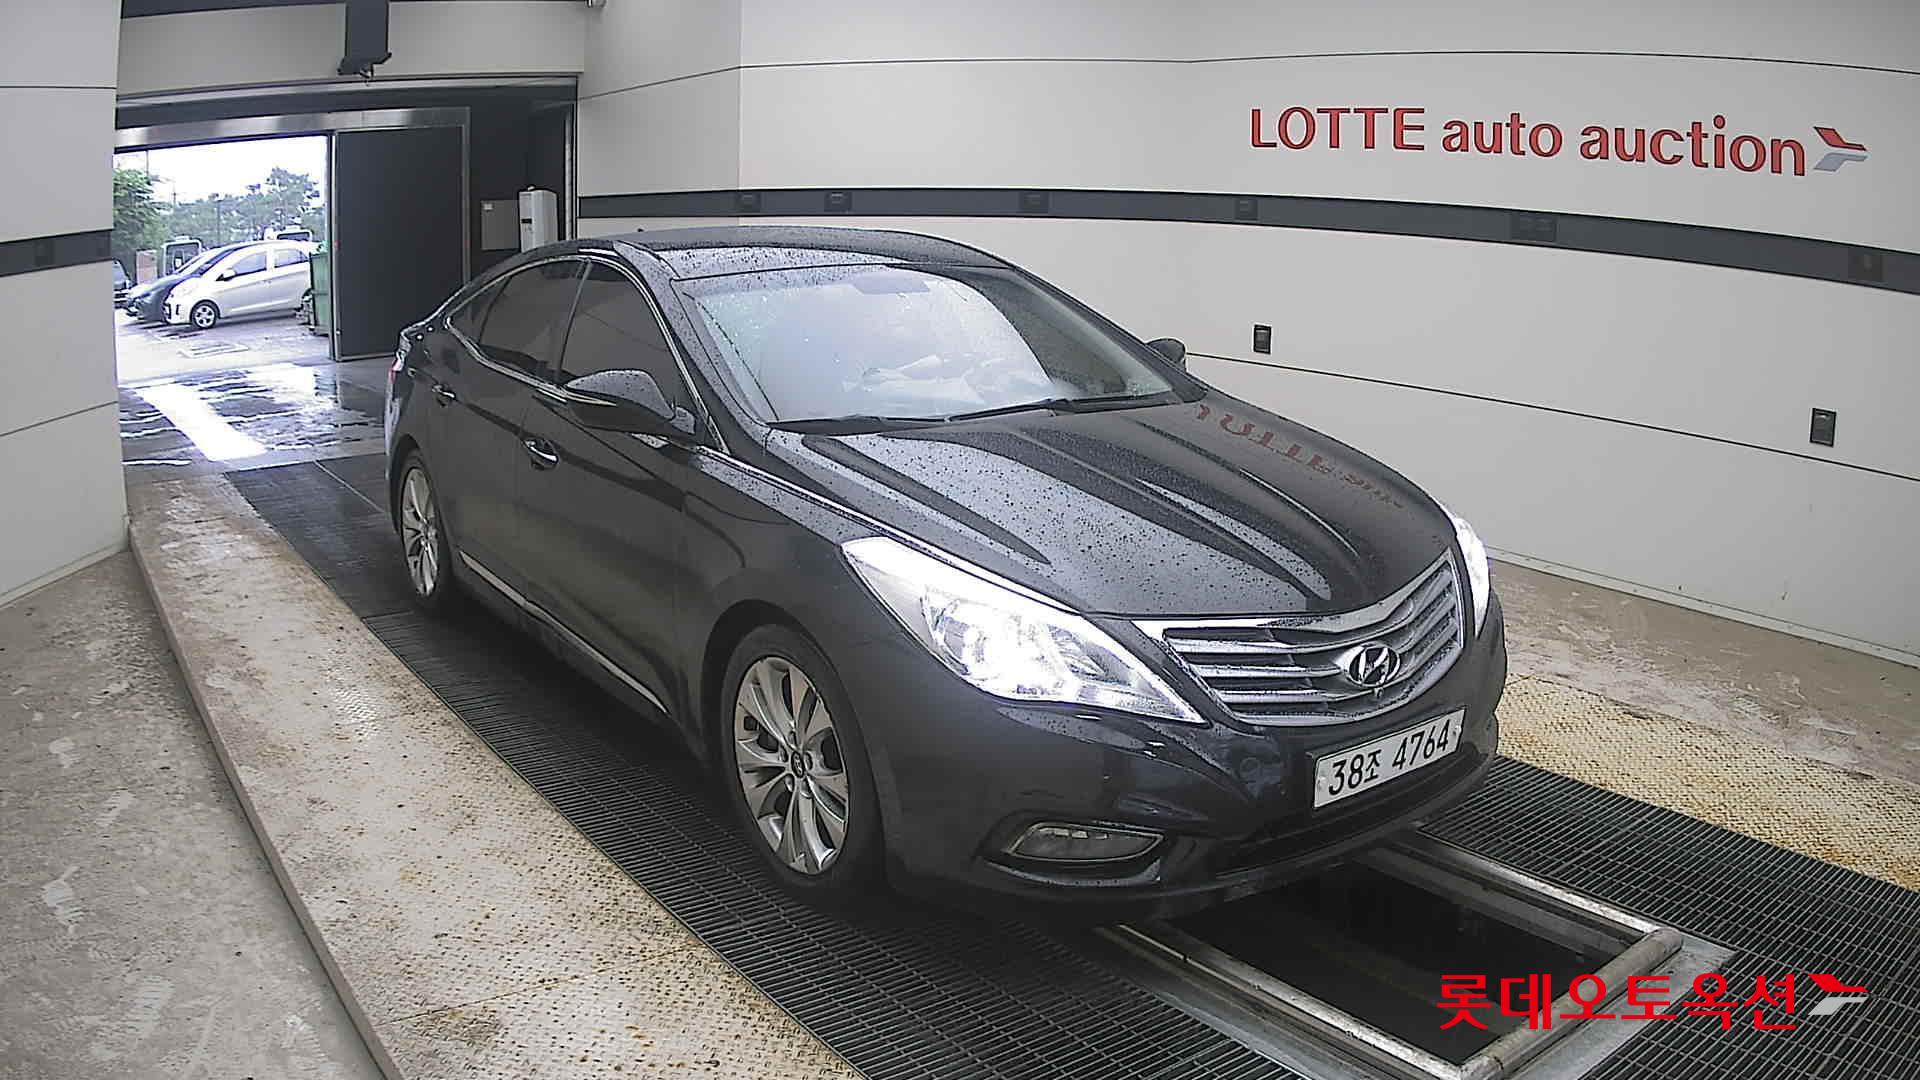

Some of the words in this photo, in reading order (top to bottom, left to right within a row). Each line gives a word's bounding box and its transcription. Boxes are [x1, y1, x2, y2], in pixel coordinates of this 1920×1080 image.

[1250, 107, 1426, 150] LOTTE
[1443, 112, 1563, 157] auto
[1580, 115, 1806, 176] auction
[1328, 749, 1382, 795] 38조
[1392, 719, 1451, 770] 4764
